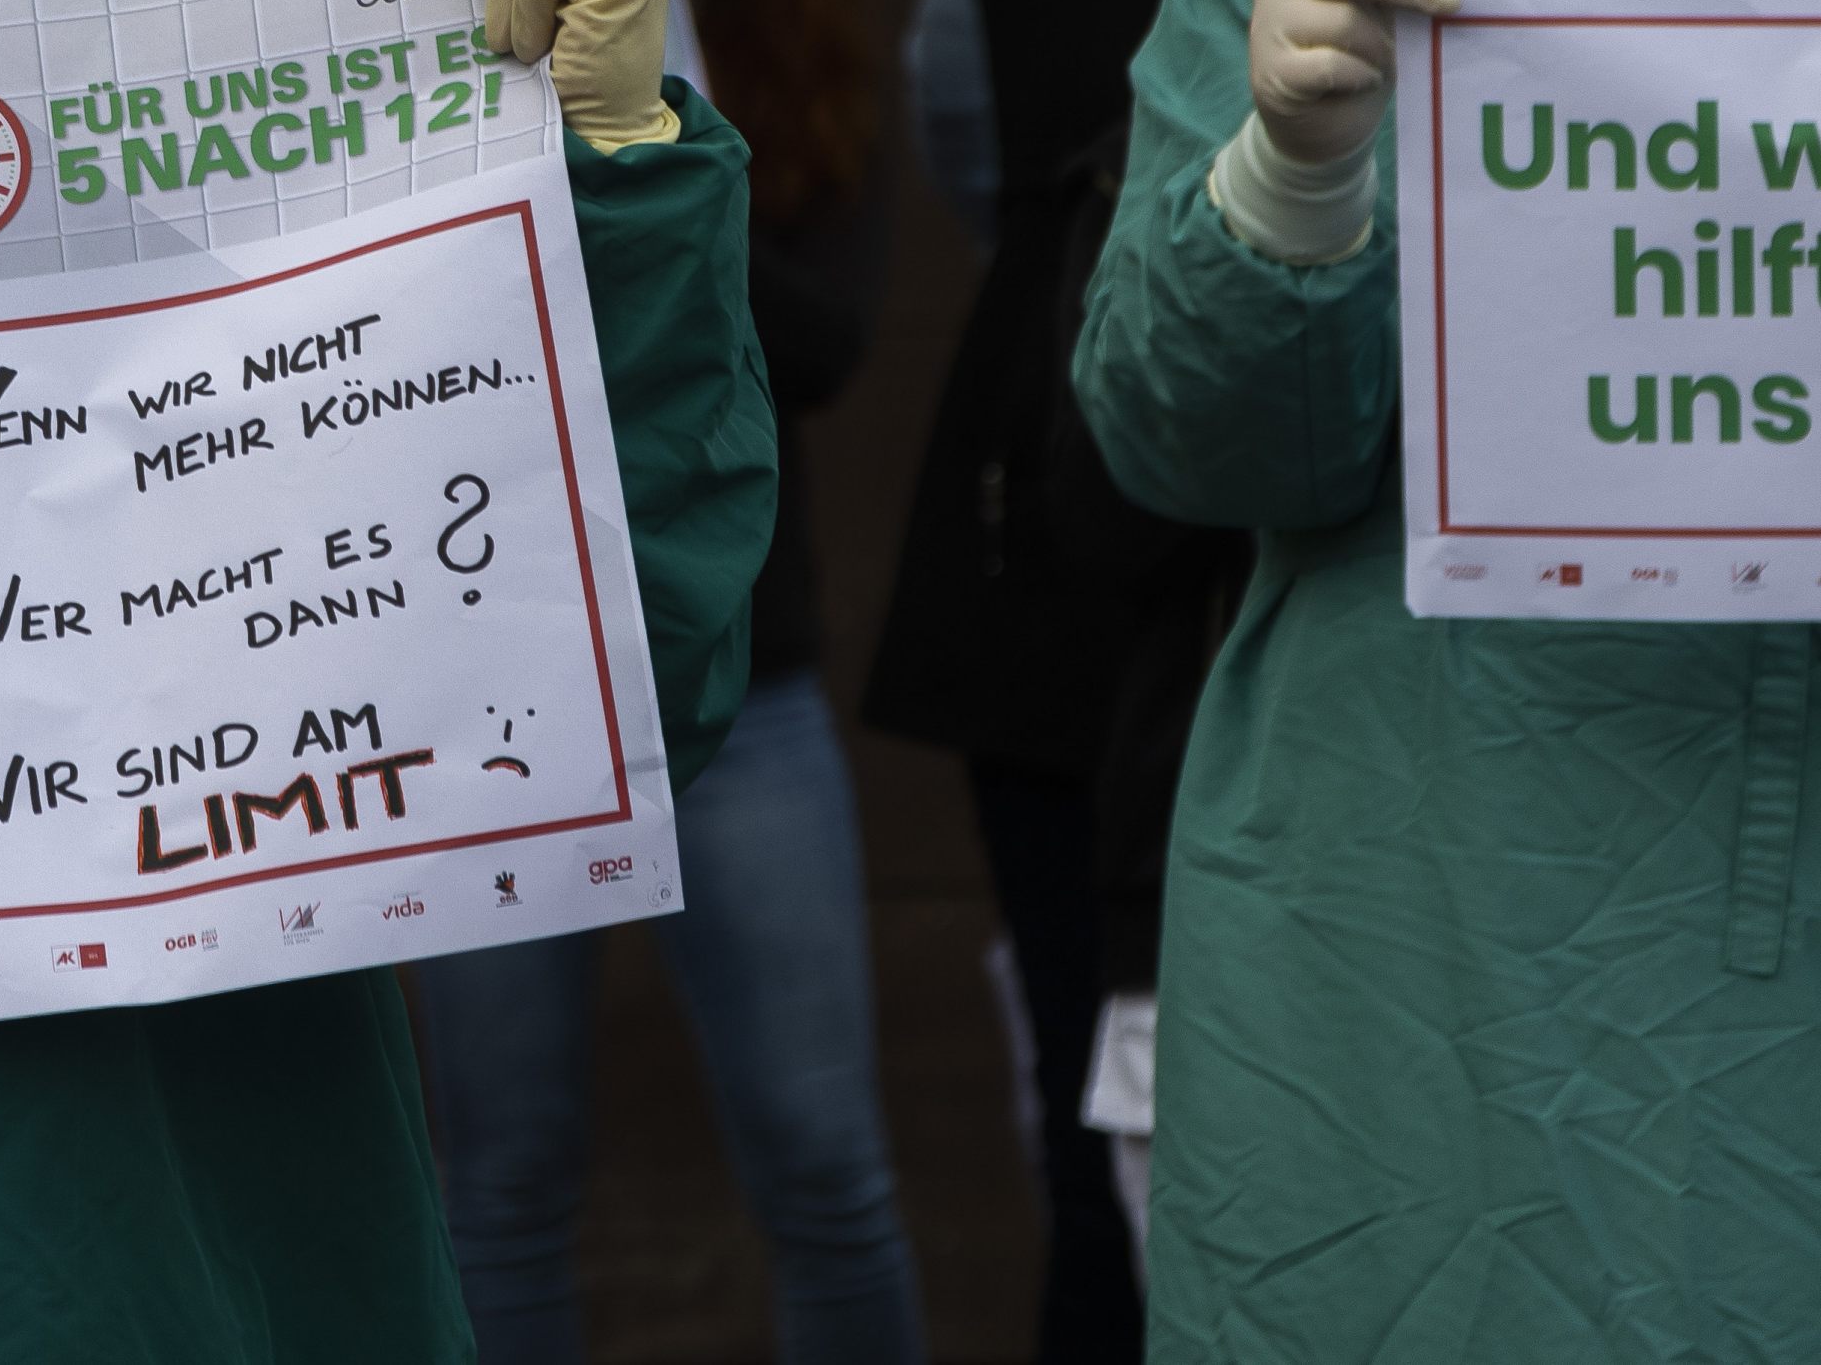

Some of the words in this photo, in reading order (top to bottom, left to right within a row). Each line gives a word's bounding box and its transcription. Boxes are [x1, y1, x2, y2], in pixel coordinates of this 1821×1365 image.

[49, 81, 164, 139] FÜR
[183, 65, 312, 120] UNS
[327, 40, 415, 94] IST
[436, 25, 502, 74] ES
[58, 148, 108, 204] 5
[119, 100, 367, 196] NACH
[385, 71, 502, 144] 12!
[1482, 99, 1720, 192] Und
[242, 315, 382, 391] NICHT
[1587, 374, 1812, 445] uns
[132, 418, 275, 492] MEHR
[121, 547, 284, 626] MACHT
[325, 523, 393, 571] ES
[243, 580, 406, 650] DANN
[116, 722, 259, 800] SIND
[292, 702, 383, 759] AM
[137, 748, 435, 876] LIMIT
[382, 895, 425, 921] vida
[588, 855, 633, 885] gpa
